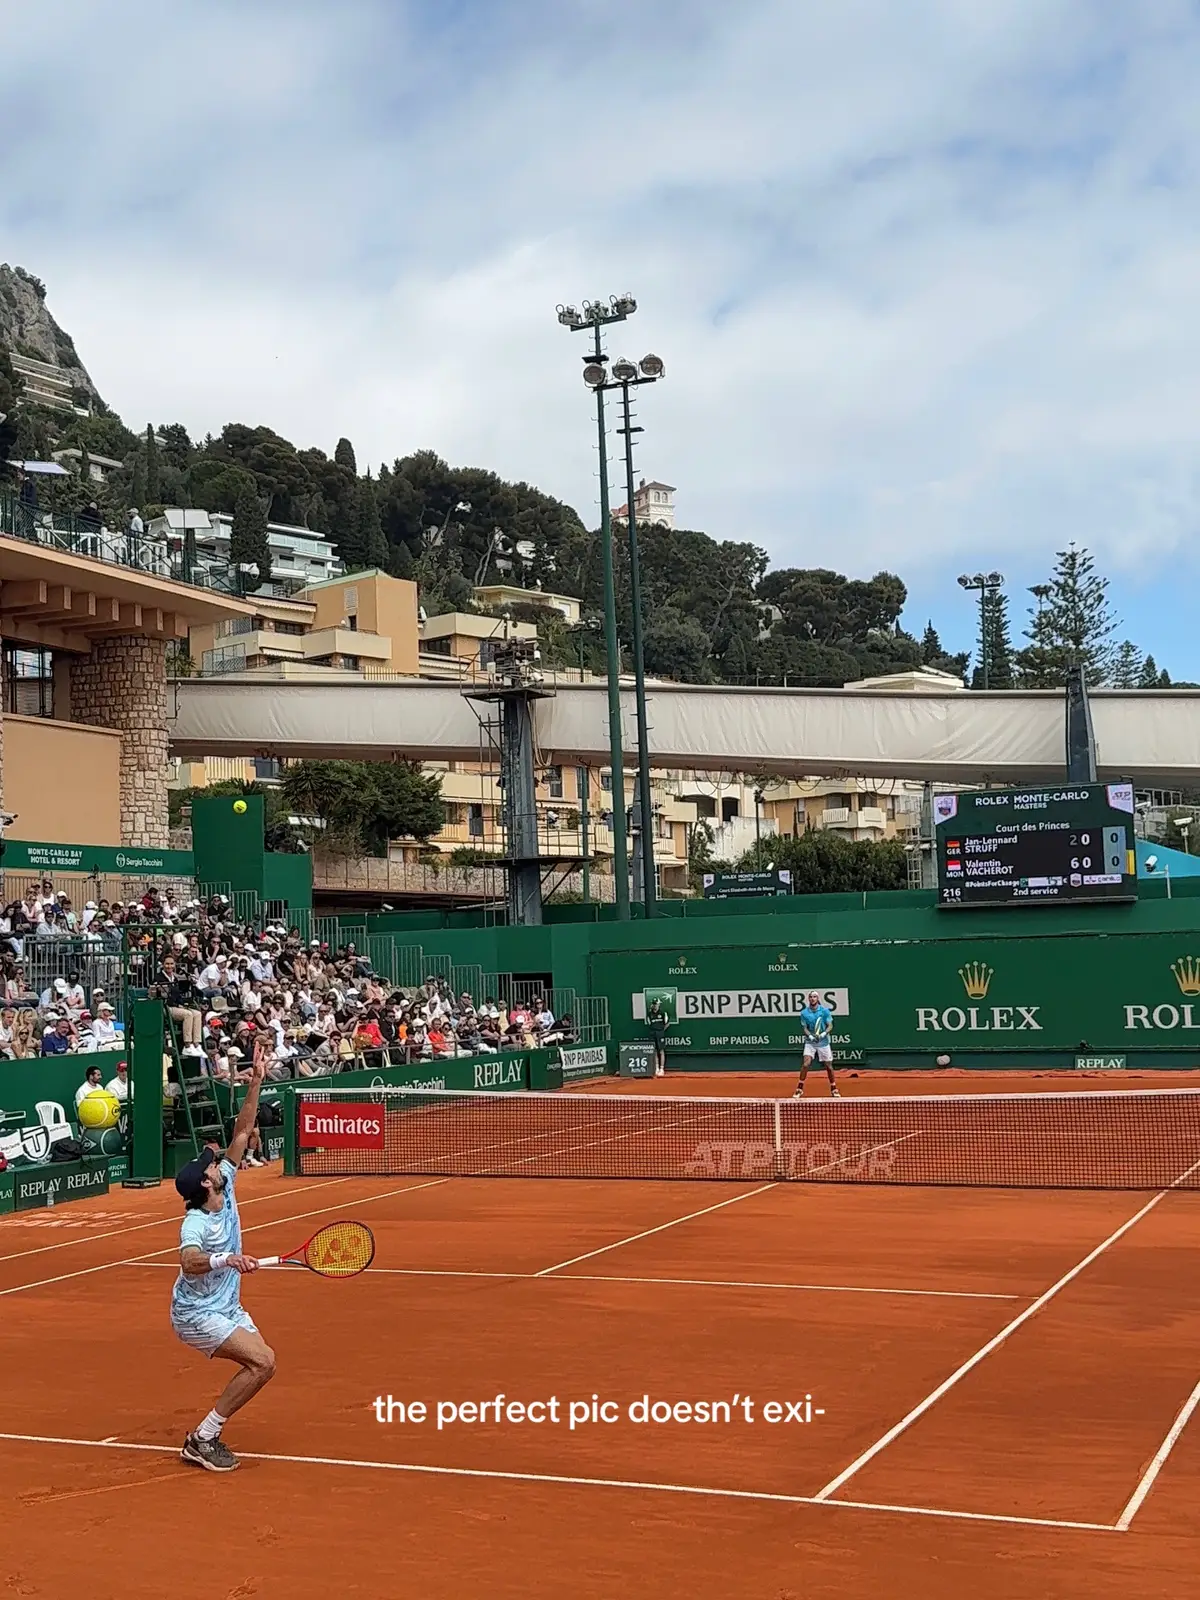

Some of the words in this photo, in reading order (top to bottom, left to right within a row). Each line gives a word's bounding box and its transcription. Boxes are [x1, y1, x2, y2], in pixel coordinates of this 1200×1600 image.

[975, 796, 1009, 806] ROLEX
[1013, 791, 1089, 803] MONTE-CARLO
[1013, 802, 1047, 810] MASTERS
[995, 824, 1019, 832] Court
[1021, 823, 1036, 831] des
[1039, 821, 1070, 830] Princes
[964, 835, 1018, 846] Jan-Lennard
[1069, 835, 1077, 845] 2
[1081, 833, 1090, 845] 0
[1110, 833, 1118, 843] 0
[27, 848, 69, 857] MONTE-CARLO
[70, 850, 83, 858] BAY
[964, 844, 998, 854] STRUFF
[30, 856, 50, 864] HOTEL
[56, 857, 81, 866] RESORT
[126, 857, 142, 867] Sergio
[143, 858, 163, 867] Tacchini
[965, 859, 1001, 868] Valentin
[1070, 857, 1079, 869] 6
[1082, 856, 1092, 868] 0
[1111, 856, 1119, 866] 0
[965, 866, 1014, 876] VACHEROT
[943, 888, 961, 897] 216
[1013, 888, 1028, 896] 2nd
[1030, 886, 1059, 895] service
[668, 967, 697, 975] ROLEX
[768, 964, 798, 972] ROLEX
[685, 993, 731, 1015] BNP
[737, 991, 838, 1014] PARIBS
[915, 1006, 1043, 1031] ROLEX
[664, 1036, 692, 1046] RIBAS
[709, 1036, 729, 1045] BNP
[730, 1035, 770, 1045] PARIBAS
[577, 1049, 604, 1065] PARIBAS
[831, 1050, 863, 1060] EPLAY
[628, 1057, 648, 1067] 216
[1076, 1057, 1124, 1069] REPLAY
[473, 1058, 524, 1088] REPLAY
[304, 1114, 380, 1135] Emirates
[683, 1141, 775, 1174] ATP
[782, 1142, 897, 1176] TOUR
[20, 1177, 62, 1198] REPLAY
[67, 1169, 106, 1190] REPLAY
